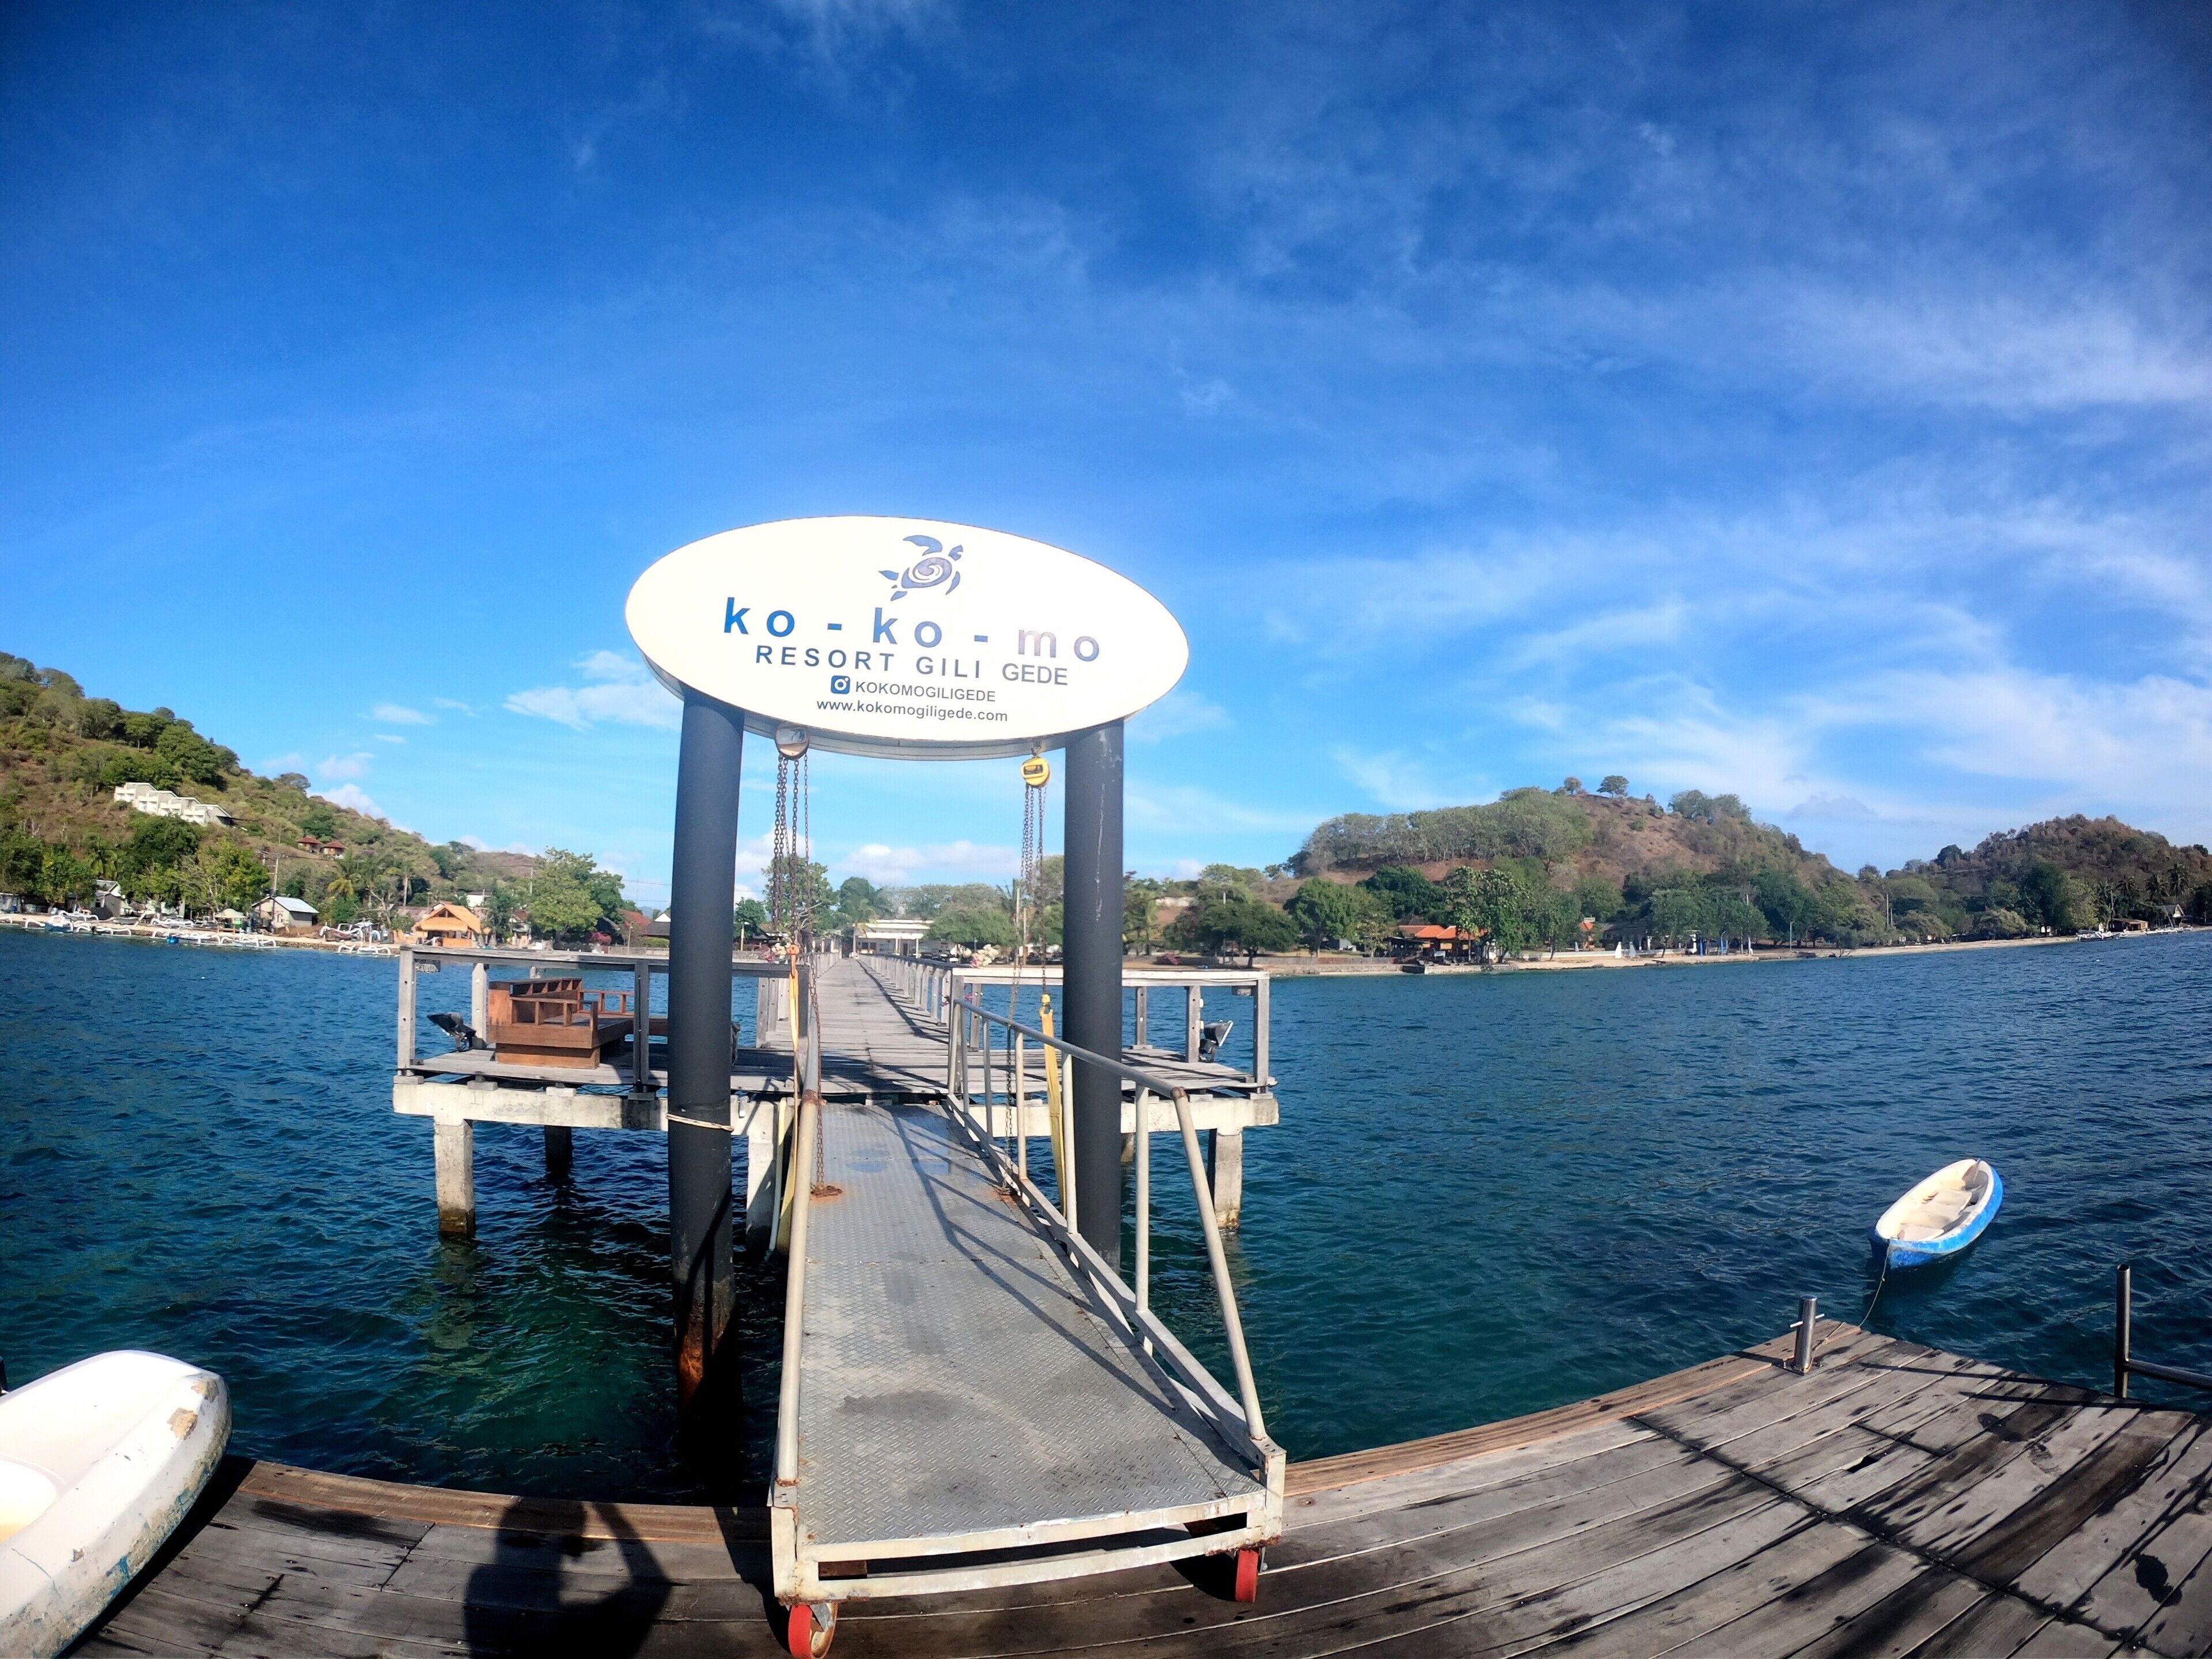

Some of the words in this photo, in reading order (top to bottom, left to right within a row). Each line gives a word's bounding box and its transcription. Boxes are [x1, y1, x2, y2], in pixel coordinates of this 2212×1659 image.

[756, 645, 895, 673] RESORT
[915, 656, 980, 679] GILI
[1002, 662, 1069, 686] GEDE
[855, 680, 996, 702] KOKOMOGILIGEDE
[816, 699, 1008, 722] www.kokomogiligede.com
